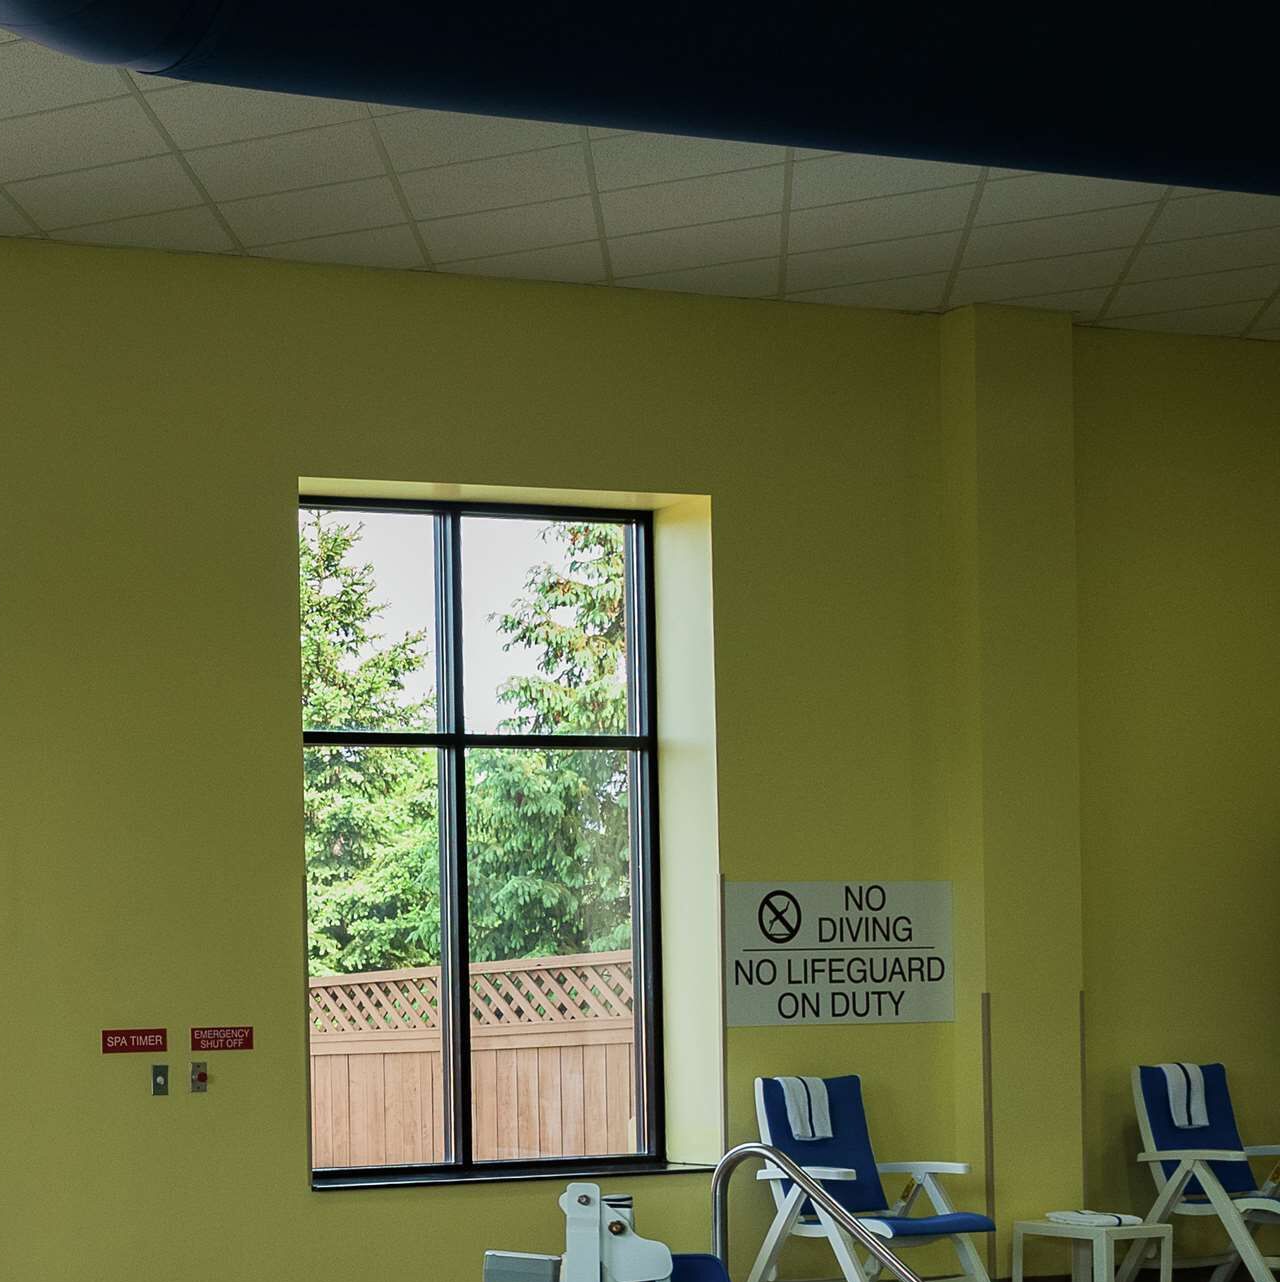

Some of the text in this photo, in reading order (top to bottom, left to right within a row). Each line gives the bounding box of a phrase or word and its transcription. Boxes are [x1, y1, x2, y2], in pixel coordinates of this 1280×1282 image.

[845, 885, 886, 912] NO
[818, 916, 912, 943] DIVING
[736, 956, 945, 985] NO LIFEGUARD
[778, 990, 905, 1019] ON DUTY
[107, 1035, 163, 1047] SPA TIMER
[194, 1029, 250, 1039] EMERGENCY
[200, 1039, 244, 1049] SHUT OFF
